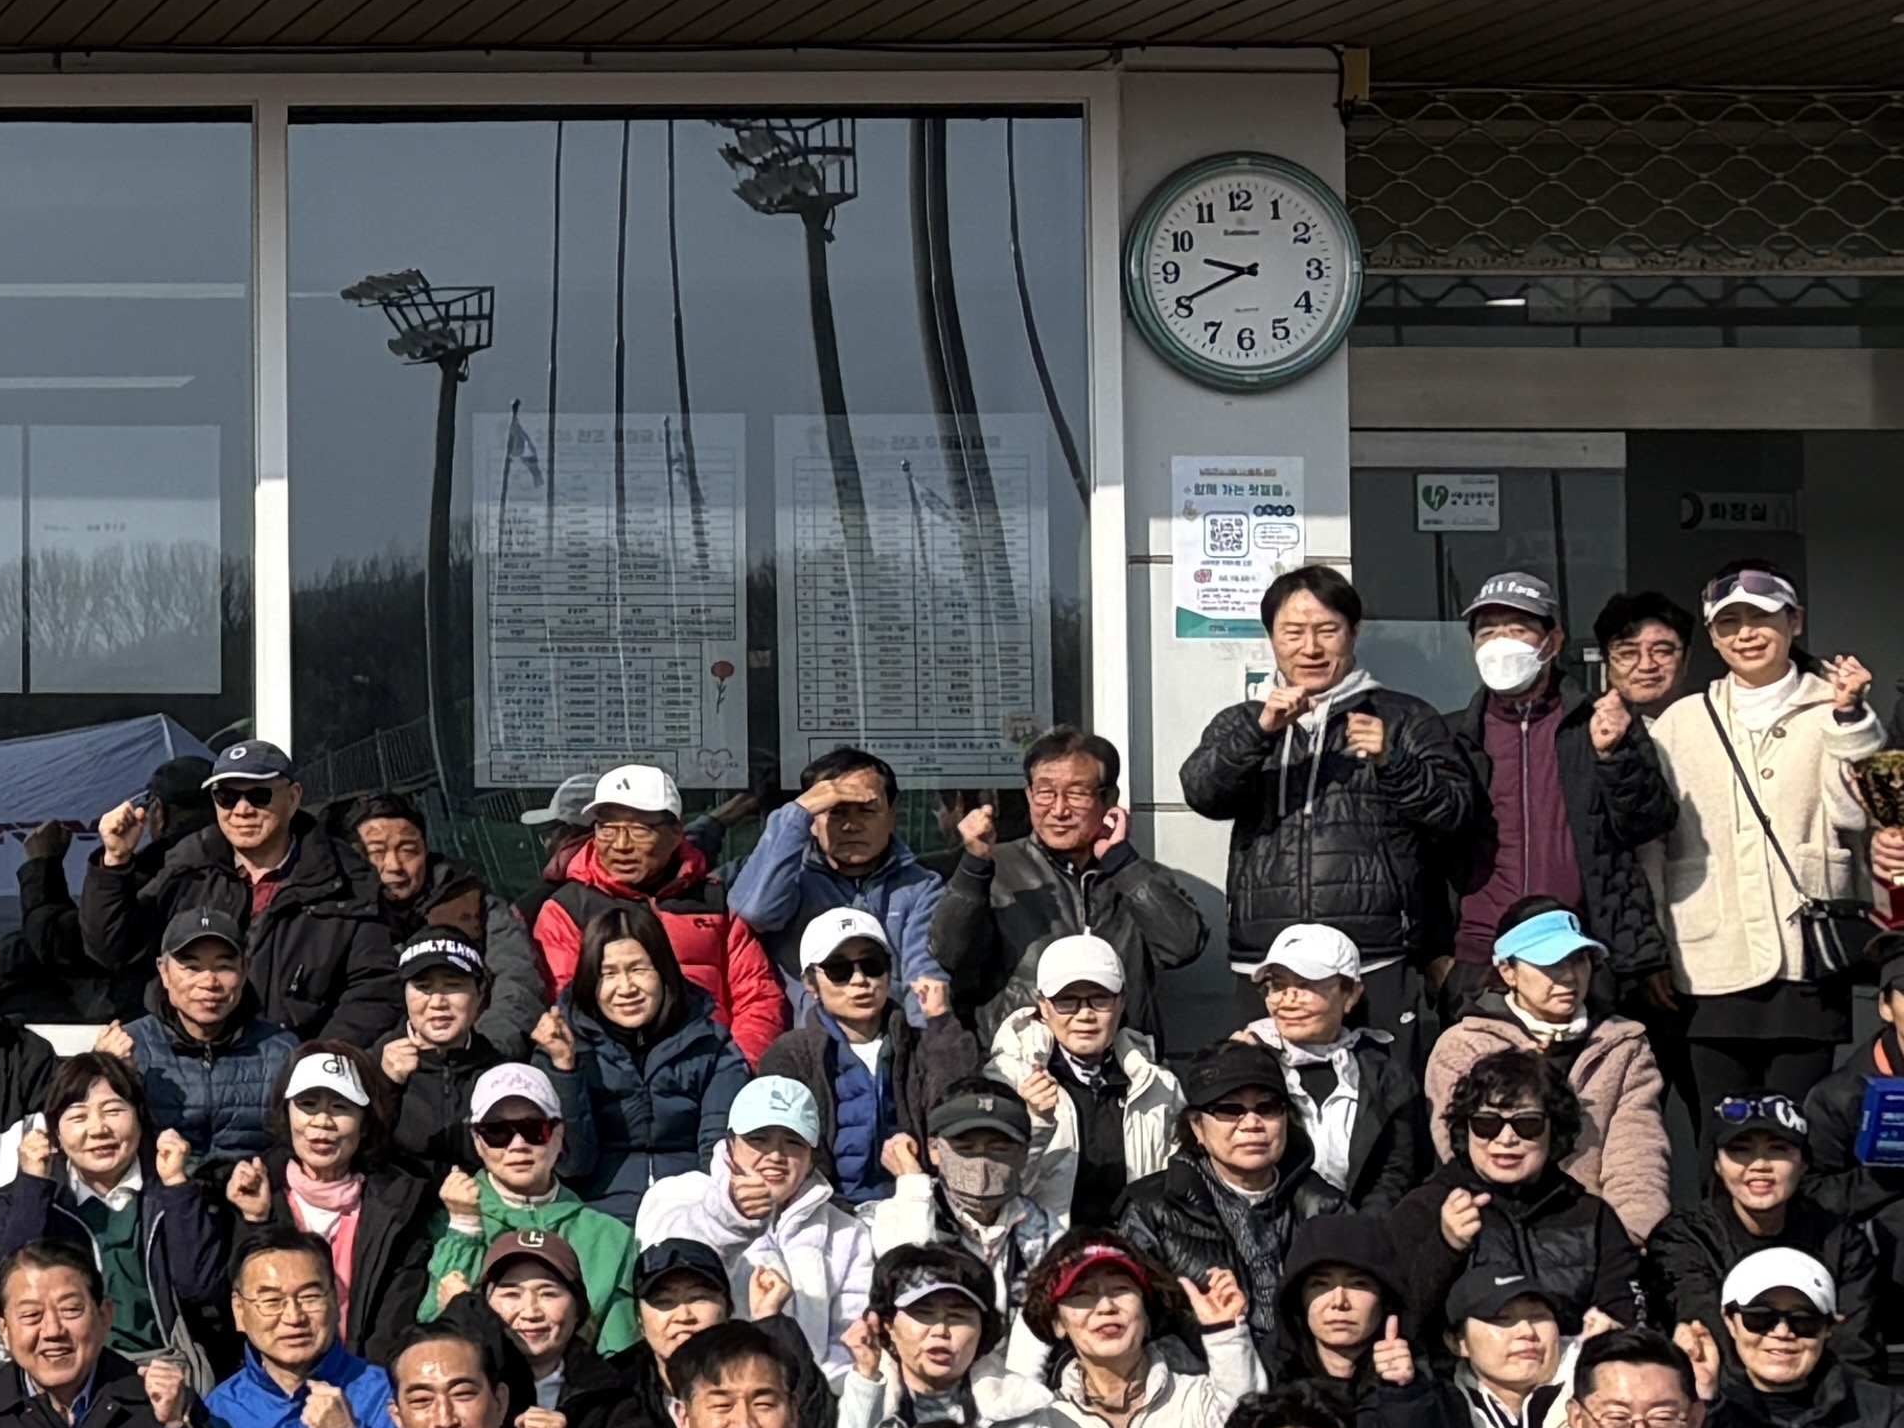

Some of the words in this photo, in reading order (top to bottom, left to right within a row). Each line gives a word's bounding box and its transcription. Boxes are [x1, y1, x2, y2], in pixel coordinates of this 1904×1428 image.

[1196, 201, 1217, 224] 11
[1226, 188, 1255, 214] 12
[1268, 196, 1283, 222] 1
[1168, 229, 1194, 254] 10
[1292, 220, 1314, 245] 2
[1158, 260, 1181, 285] 9
[1304, 257, 1327, 281] 3
[1174, 295, 1198, 320] 8
[1293, 290, 1314, 315] 4
[1202, 320, 1223, 346] 7
[1236, 327, 1256, 352] 6
[1271, 317, 1291, 343] 5
